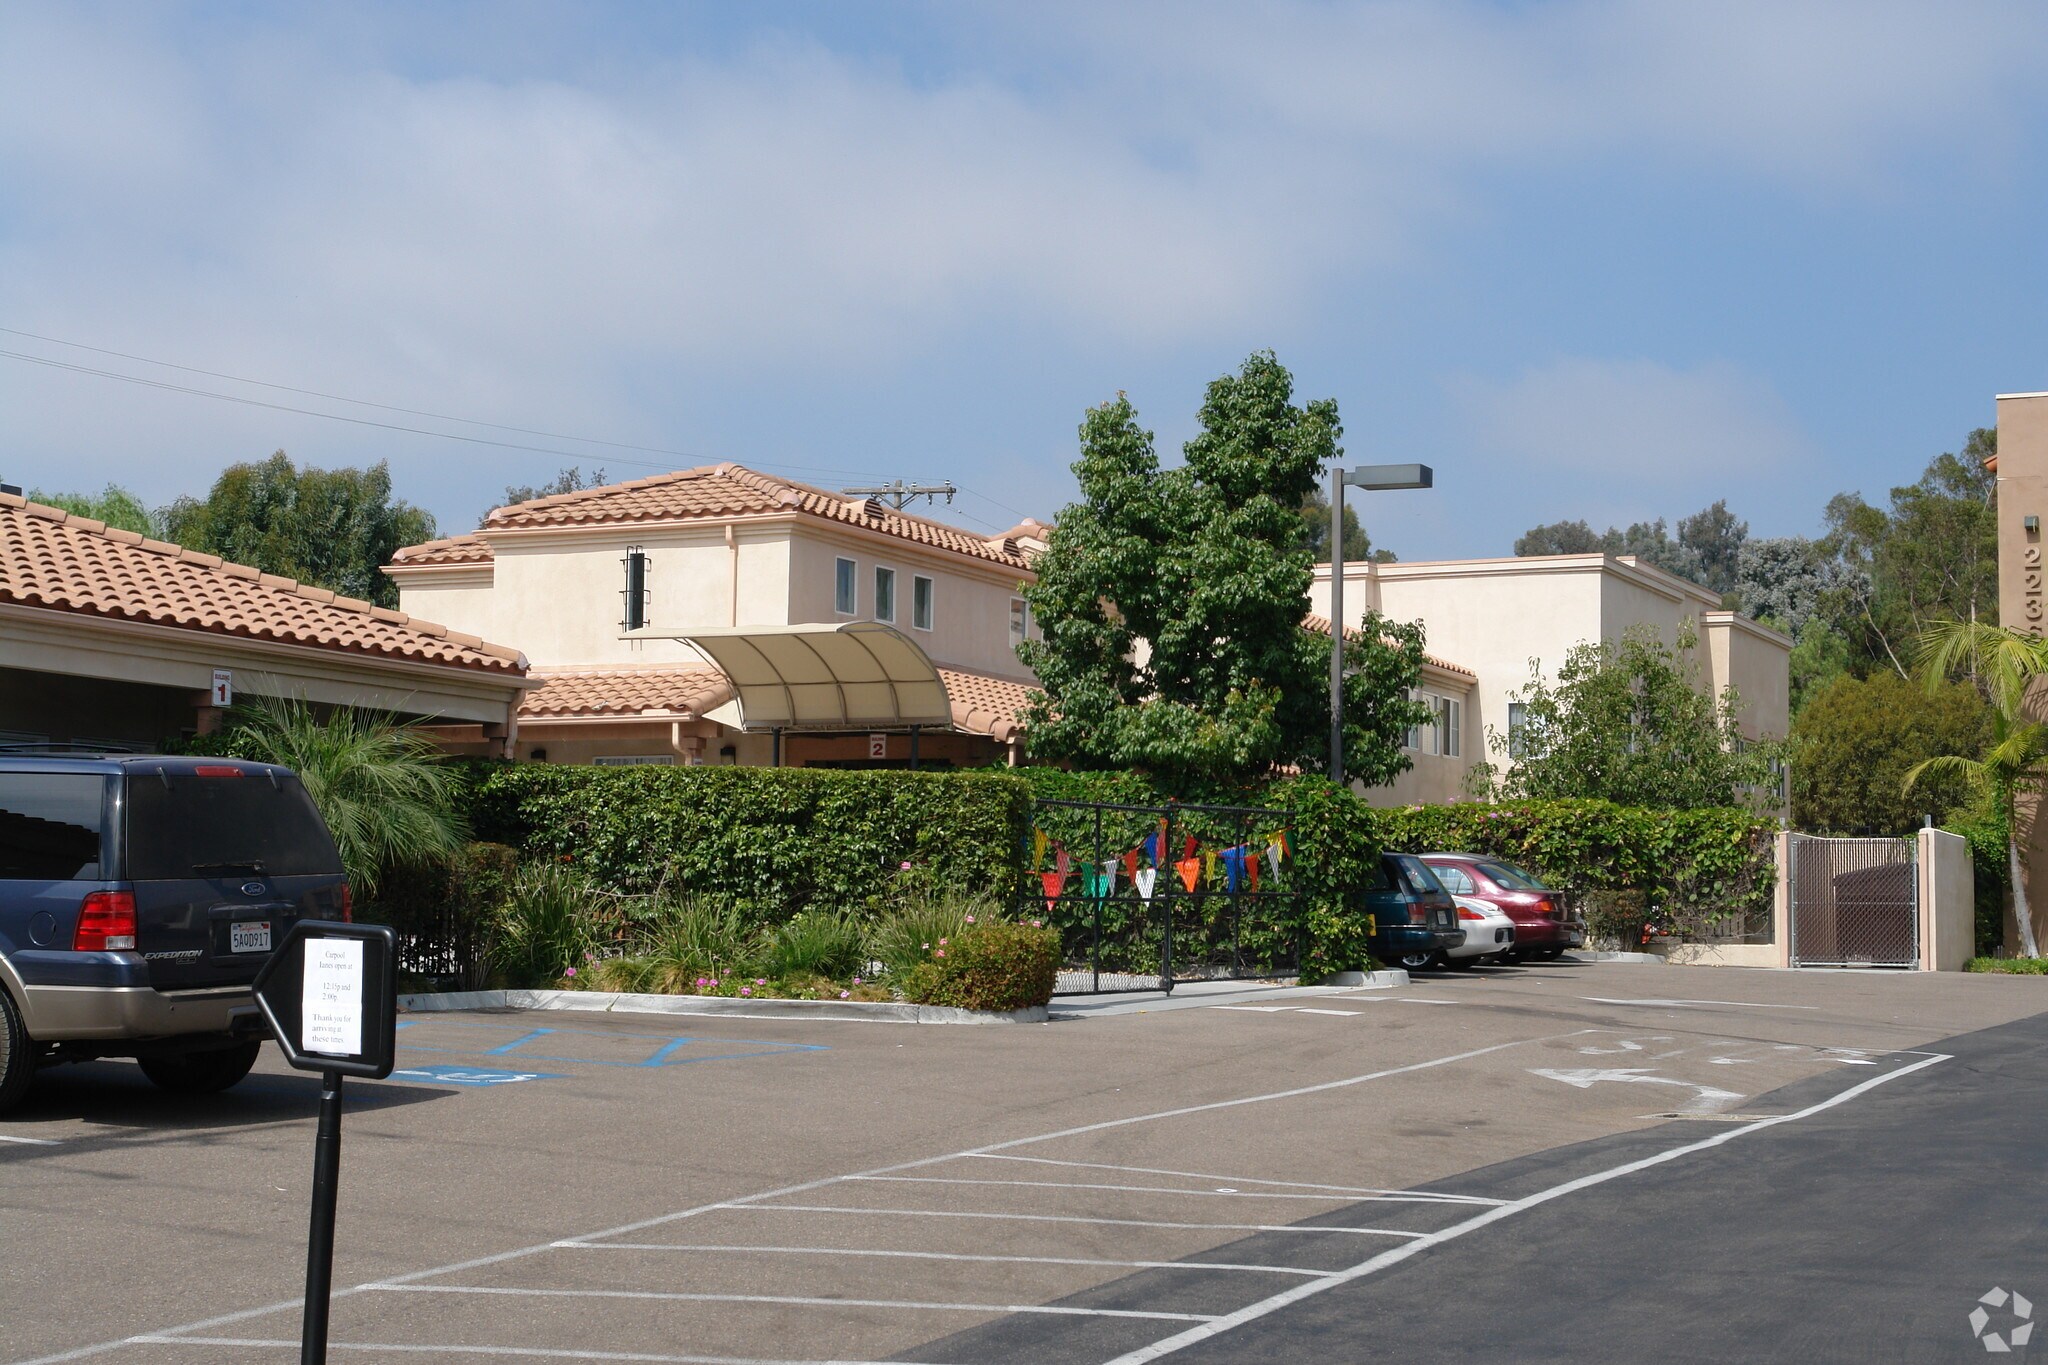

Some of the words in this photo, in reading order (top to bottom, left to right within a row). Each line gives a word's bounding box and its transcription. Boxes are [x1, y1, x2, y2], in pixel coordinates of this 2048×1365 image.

[217, 684, 226, 702] 1
[872, 742, 884, 756] 2
[144, 949, 203, 960] EXPEDITION
[325, 951, 345, 960] Carpool
[334, 962, 347, 971] open
[312, 1013, 333, 1022] Thank
[333, 1015, 343, 1024] you
[343, 1015, 352, 1023] for
[311, 1026, 336, 1034] arriving
[312, 1034, 330, 1042] these
